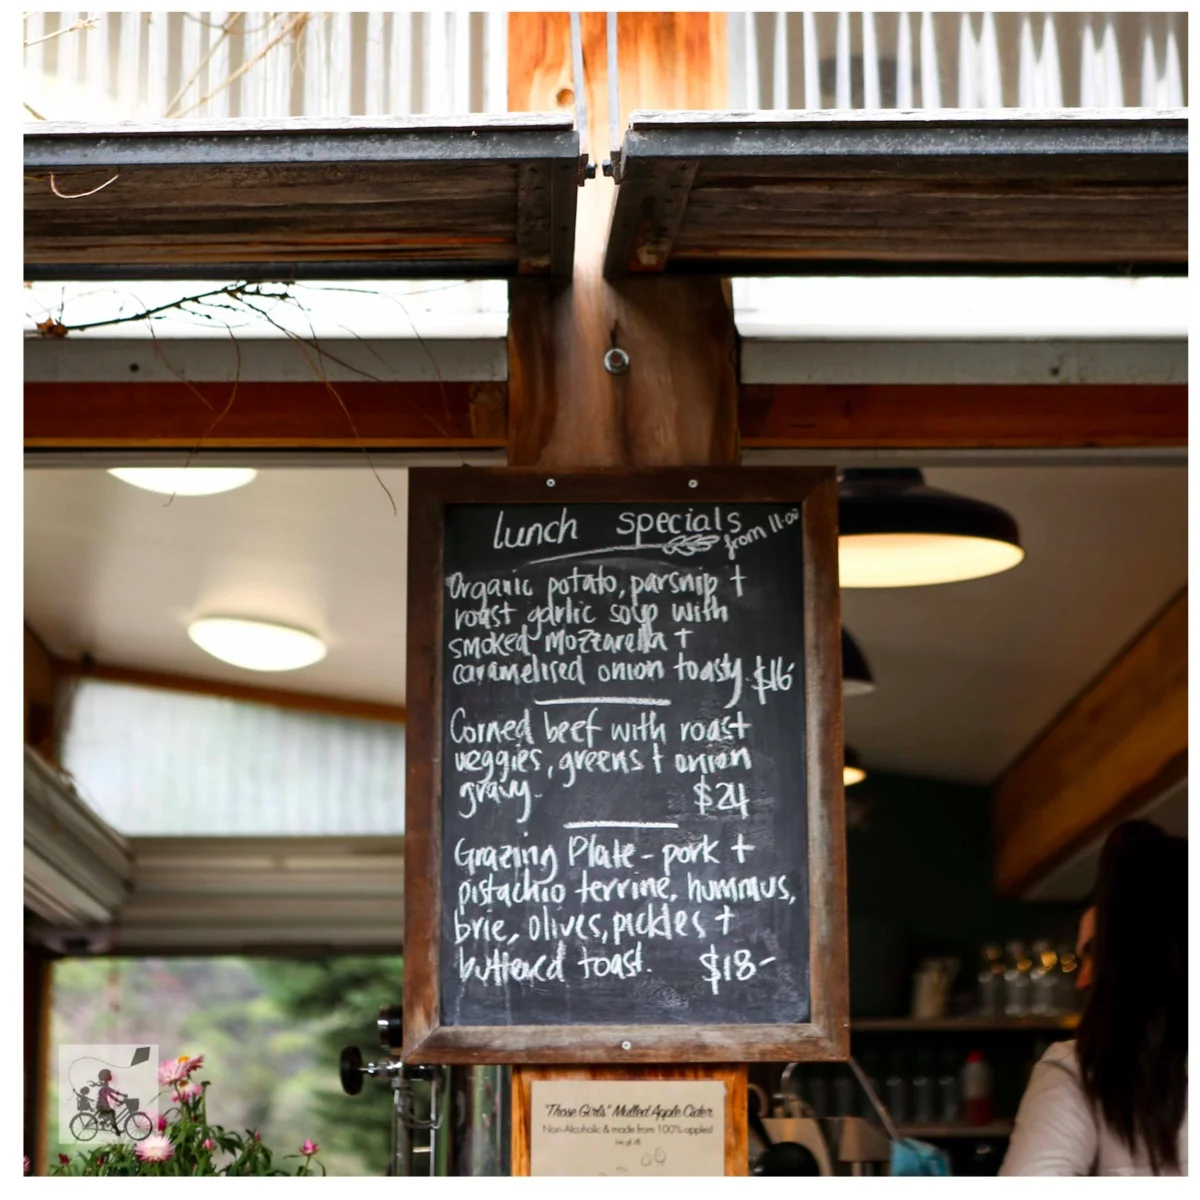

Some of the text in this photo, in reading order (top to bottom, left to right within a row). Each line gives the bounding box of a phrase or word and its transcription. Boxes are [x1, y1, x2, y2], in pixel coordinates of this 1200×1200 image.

[615, 507, 742, 546] specials
[723, 533, 768, 561] from
[450, 570, 533, 608] Organic
[549, 565, 626, 608] potato,
[630, 567, 718, 606] parsnip
[455, 595, 729, 641] roast garlic soup with
[448, 623, 532, 660] smoked
[452, 653, 587, 686] caramelised
[597, 659, 665, 682] onion
[450, 707, 752, 749] Corned beef with roast
[558, 749, 645, 788] greens
[674, 747, 753, 774] onion
[692, 774, 751, 820] $24
[453, 831, 559, 885] Grazing
[569, 834, 637, 869] Plate
[661, 834, 720, 876] pork
[458, 867, 567, 916] pistachio
[453, 904, 520, 945] brie,
[529, 904, 608, 944] olives,
[613, 903, 706, 946] pickles
[602, 1124, 611, 1134] &
[611, 1124, 635, 1134] made
[636, 1124, 655, 1134] from
[612, 1104, 649, 1118] Mulled
[651, 1104, 682, 1121] Apple
[682, 1104, 714, 1118] Cider
